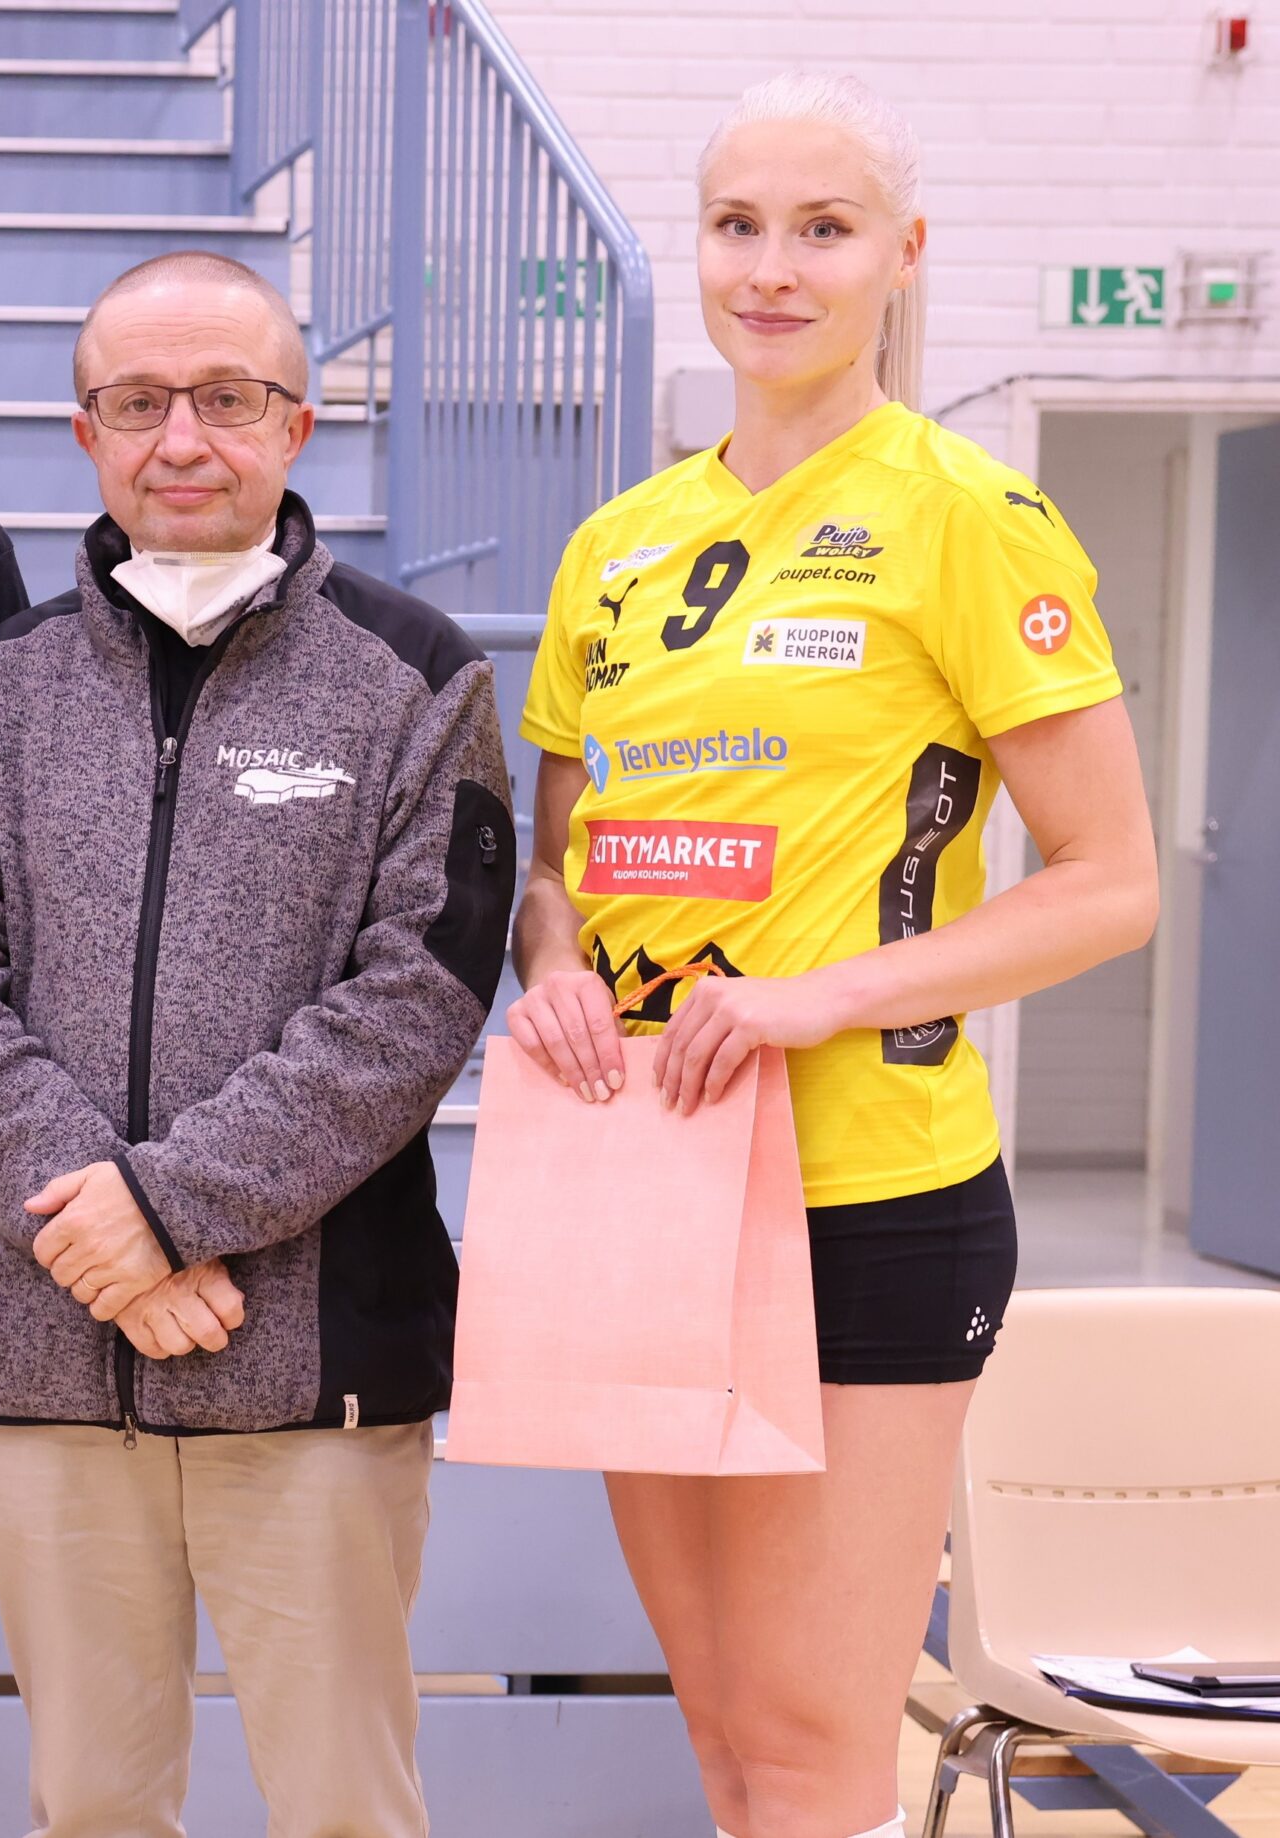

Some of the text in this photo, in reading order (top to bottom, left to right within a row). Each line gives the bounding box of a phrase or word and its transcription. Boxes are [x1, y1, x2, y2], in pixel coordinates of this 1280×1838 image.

[771, 566, 876, 585] joupet.com
[661, 540, 750, 652] 9
[786, 628, 859, 644] KUOPION
[784, 645, 856, 662] ENERGIA
[615, 727, 788, 772] Terveystalo
[594, 834, 763, 869] CITYMARKET
[899, 761, 957, 939] EUGEOT
[637, 870, 689, 881] KOLMISOPPI
